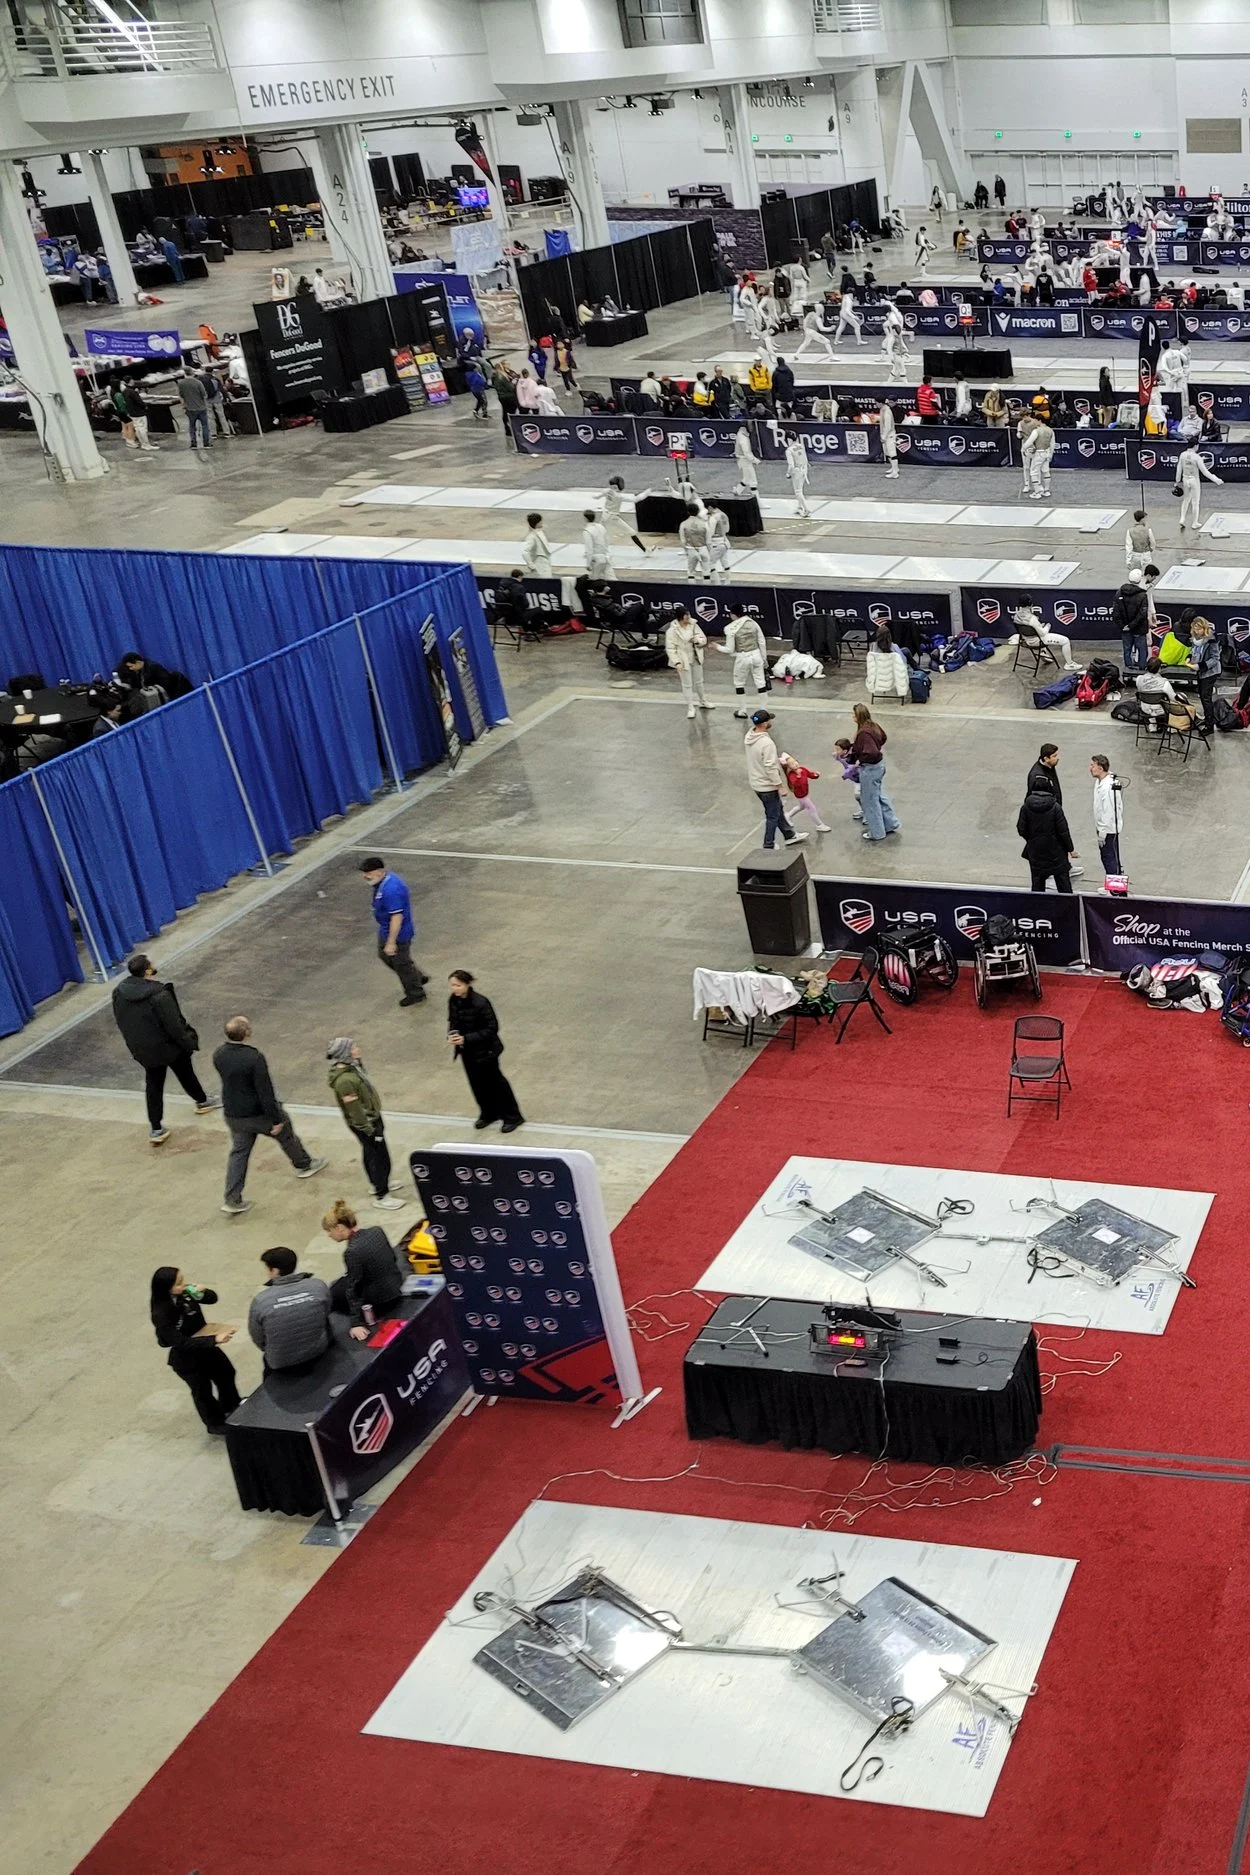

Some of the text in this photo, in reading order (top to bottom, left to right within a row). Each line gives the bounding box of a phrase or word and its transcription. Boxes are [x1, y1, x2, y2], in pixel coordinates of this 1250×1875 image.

[248, 75, 396, 108] EMERGENCY EXIT
[332, 174, 350, 225] A24
[1012, 316, 1056, 328] macron
[598, 429, 624, 437] USA
[773, 428, 839, 454] Rnge
[1219, 456, 1248, 464] USA
[898, 610, 934, 619] USA
[884, 910, 936, 923] USA
[1113, 914, 1190, 938] Shop at the
[1112, 935, 1148, 945] Official
[1149, 938, 1170, 947] USA
[1172, 940, 1210, 951] Fencing
[1212, 941, 1243, 952] Merch
[1130, 1285, 1148, 1300] AF
[396, 1338, 448, 1398] USA
[409, 1359, 448, 1407] FENCING
[952, 1722, 978, 1748] AF
